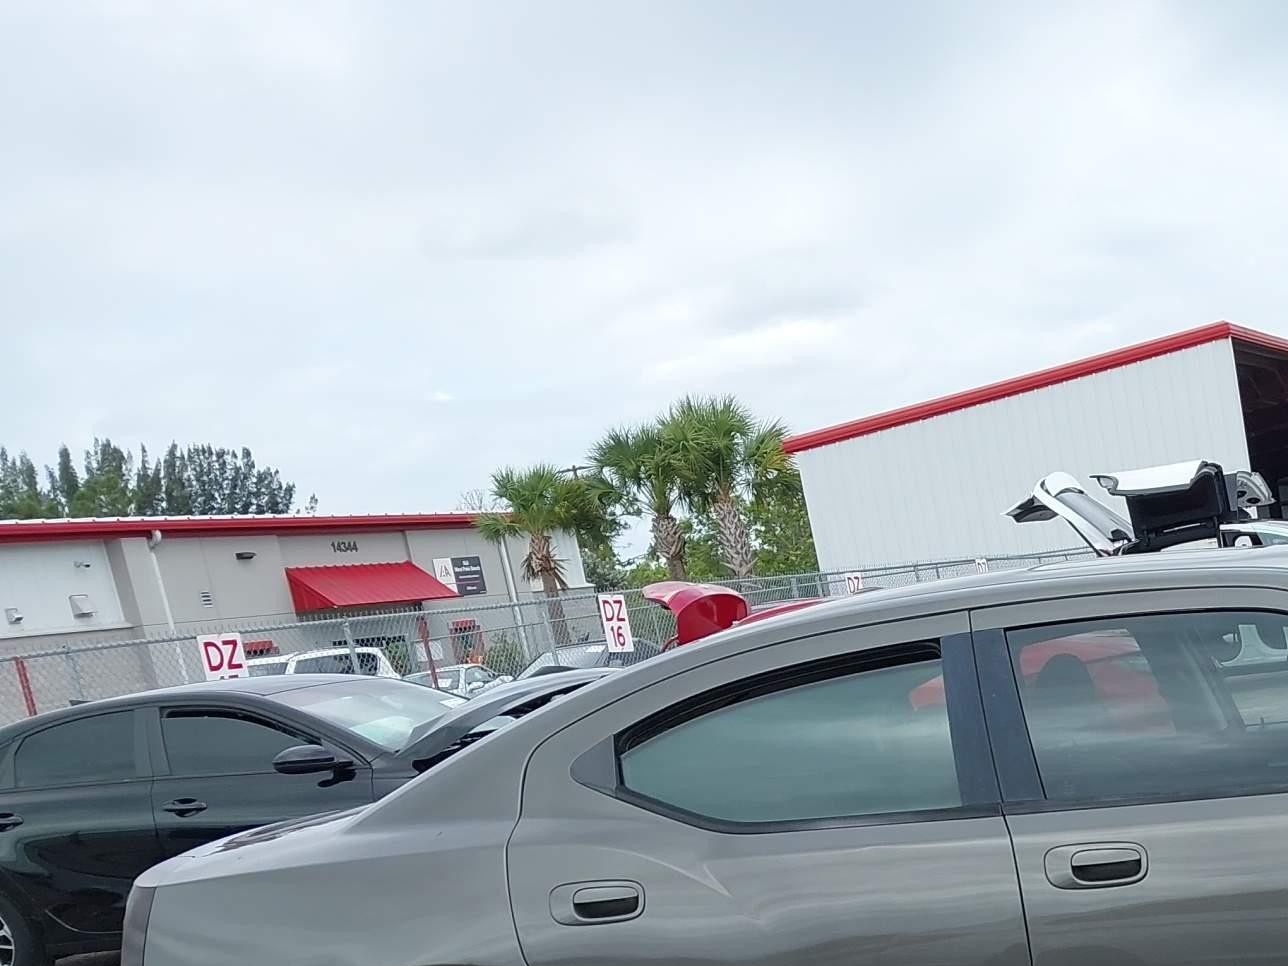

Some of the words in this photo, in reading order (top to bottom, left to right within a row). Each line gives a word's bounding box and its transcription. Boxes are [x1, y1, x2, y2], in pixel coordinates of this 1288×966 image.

[330, 540, 358, 553] 14344
[602, 599, 626, 622] DZ
[610, 625, 626, 648] 16
[203, 639, 244, 672] DZ
